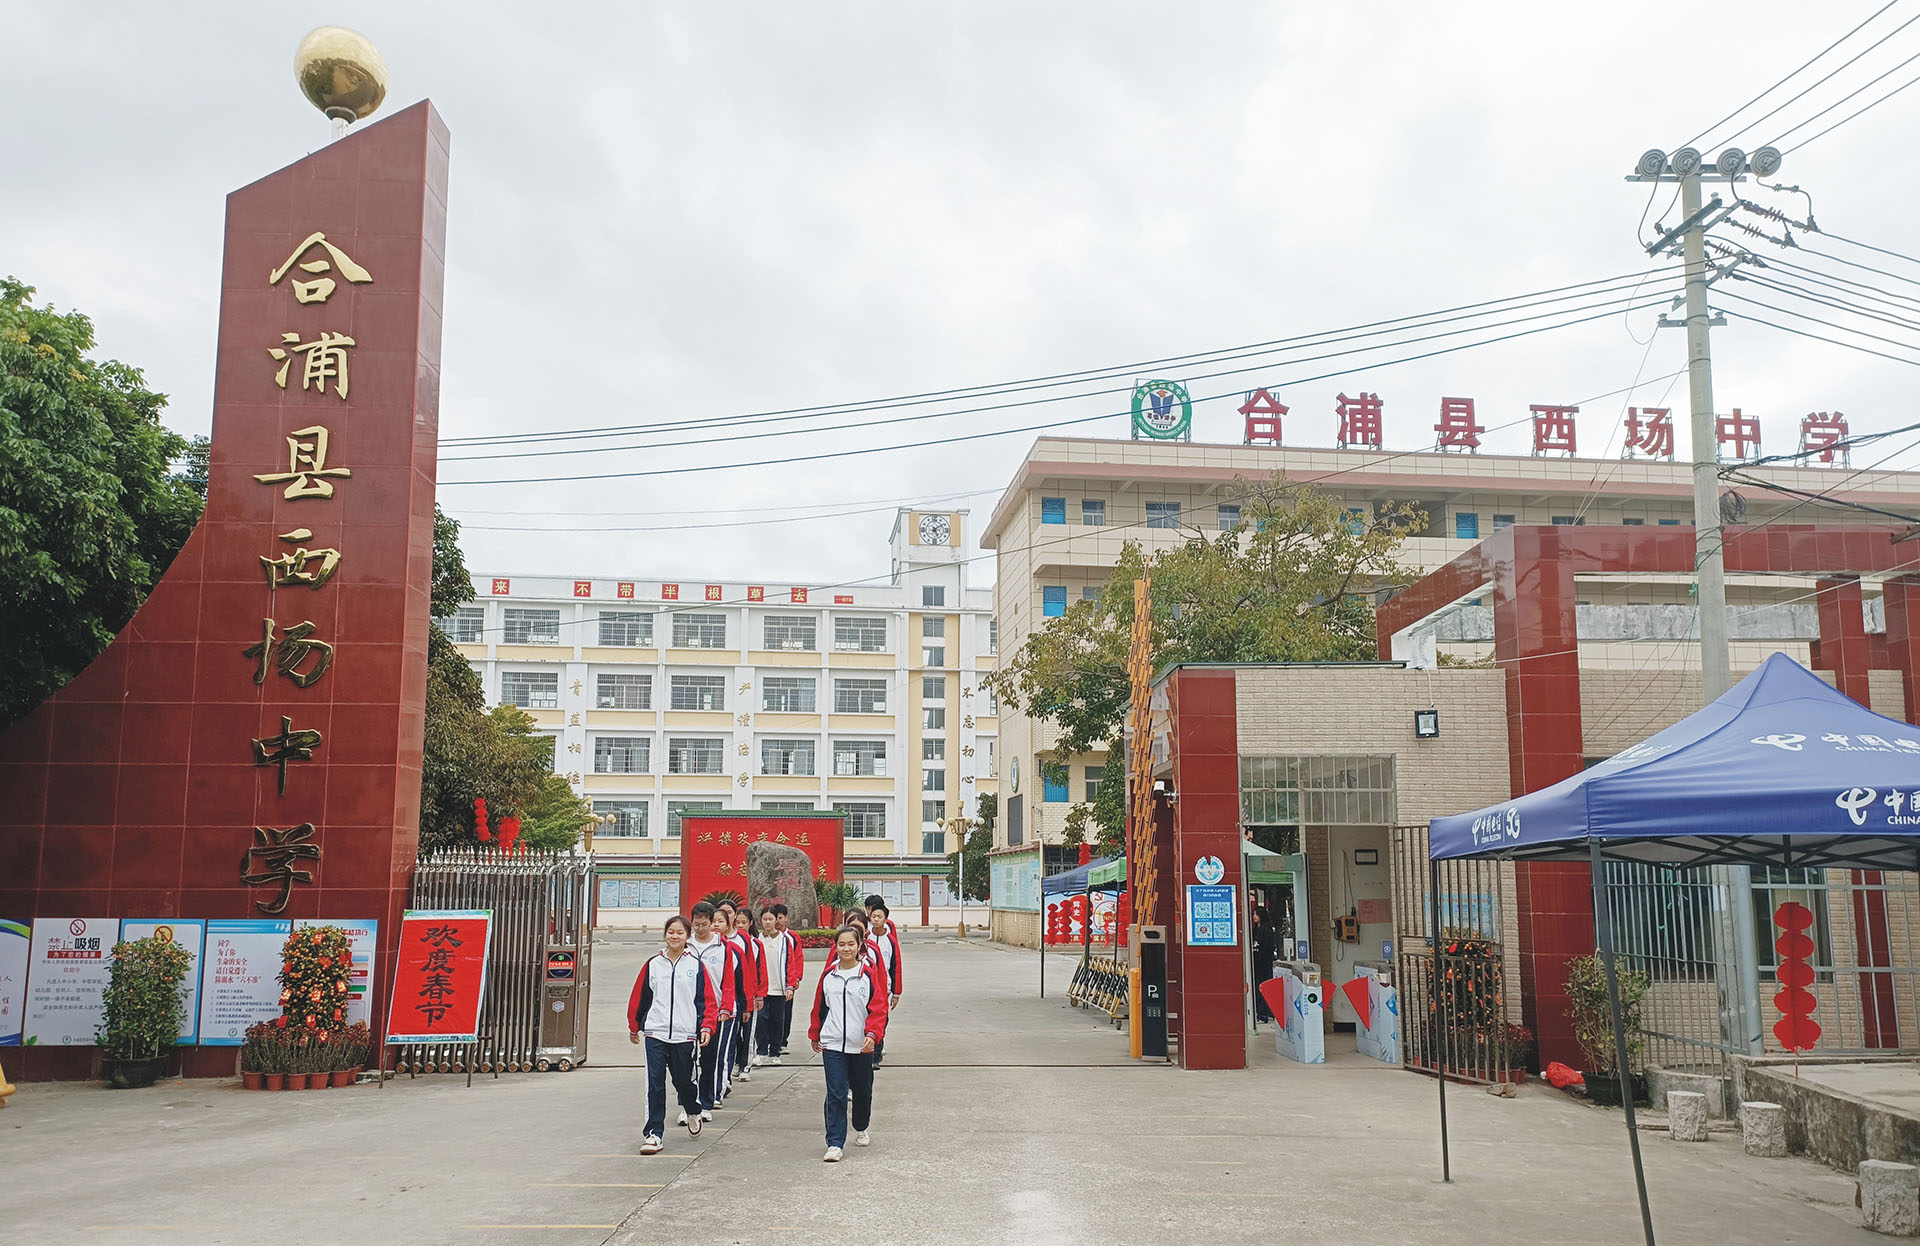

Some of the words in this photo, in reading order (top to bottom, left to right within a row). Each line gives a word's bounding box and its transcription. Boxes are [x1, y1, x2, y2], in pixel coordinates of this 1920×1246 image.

[1237, 388, 1850, 462] 合浦县西场中学
[239, 231, 374, 915] 合浦县西场中学
[577, 584, 806, 602] 不带半根草去
[737, 682, 751, 787] 严谨治学
[962, 687, 975, 784] 不忘初心
[697, 831, 812, 847] 拼搏改变命运
[48, 937, 100, 950] 禁止吸烟
[218, 939, 230, 947] 同学
[218, 948, 236, 956] 为了你
[216, 967, 247, 975] 请自觉遵守
[414, 924, 463, 1028] 欢度春节
[1148, 985, 1158, 997] P
